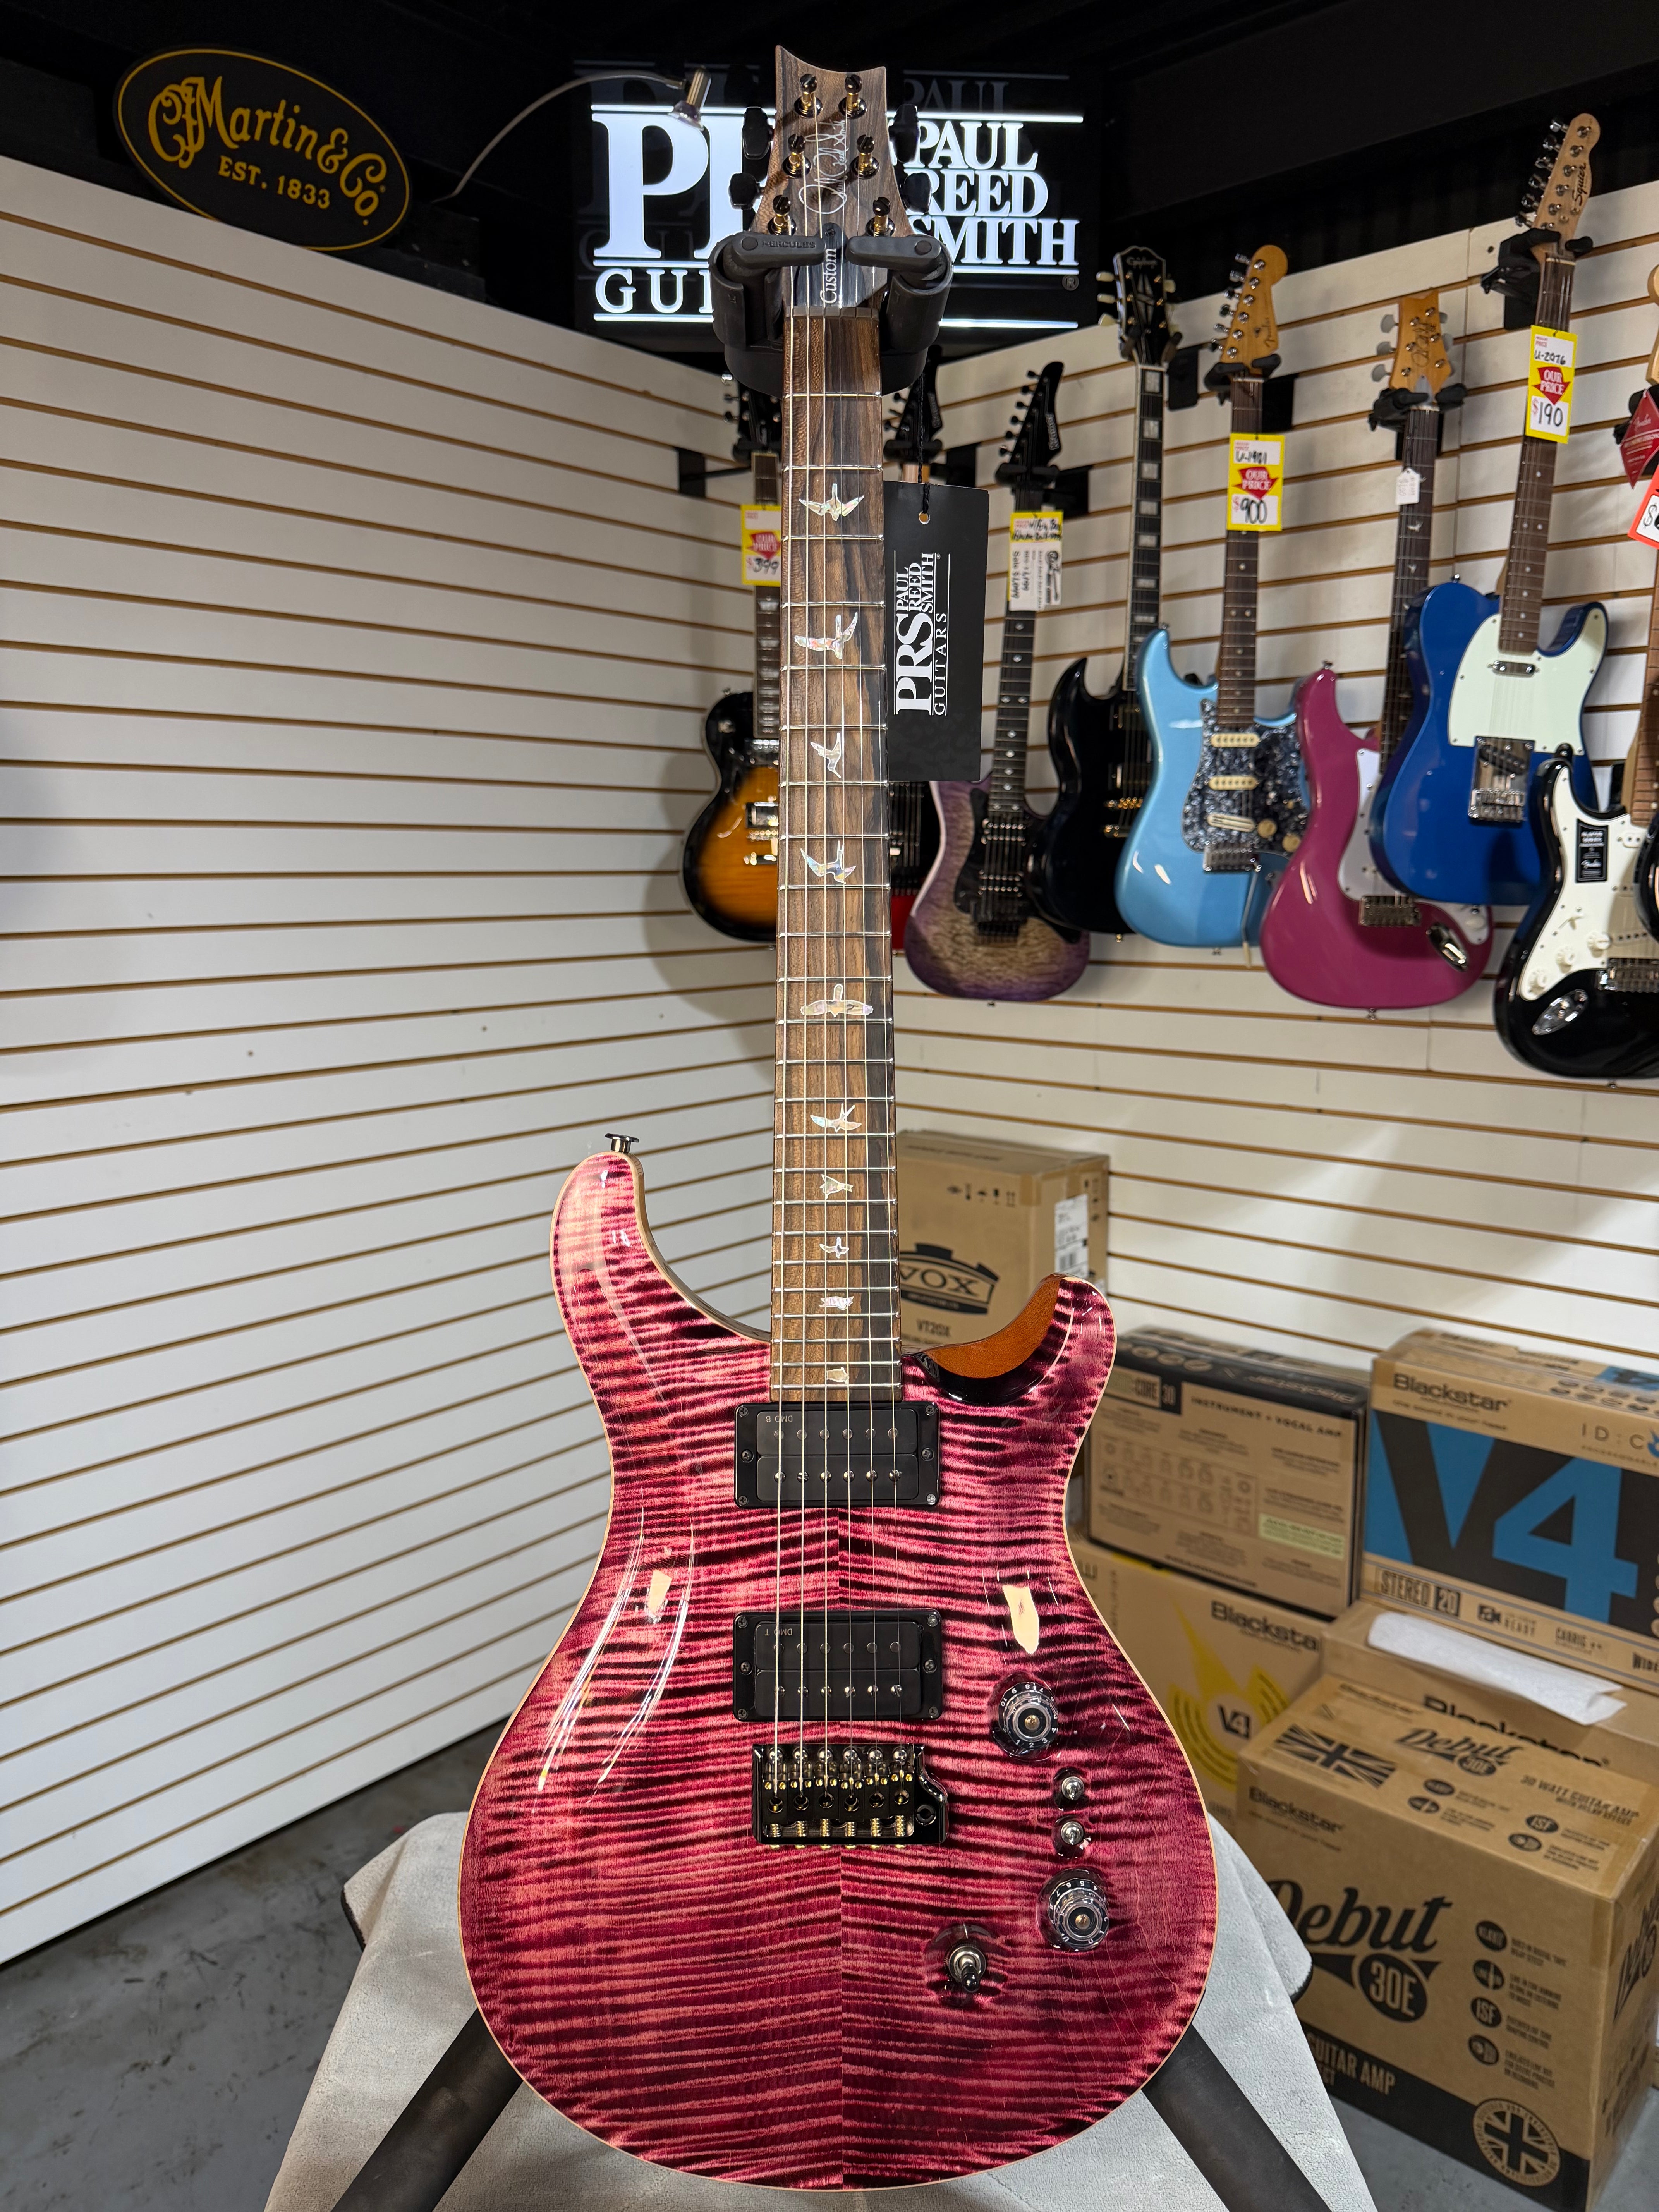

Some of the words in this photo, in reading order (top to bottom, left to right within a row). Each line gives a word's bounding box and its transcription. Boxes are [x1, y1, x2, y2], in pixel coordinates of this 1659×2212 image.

[218, 156, 267, 189] EST.
[277, 175, 330, 209] 1833
[1572, 162, 1587, 206] Squier
[762, 240, 816, 249] HERCULES
[820, 247, 837, 304] Custom
[1540, 380, 1565, 395] PRICE
[1543, 369, 1562, 383] OUR
[1531, 398, 1563, 427] $190
[1242, 480, 1272, 491] PRICE
[1245, 469, 1268, 481] OUR
[1232, 496, 1268, 524] $900
[896, 567, 909, 610] PAUL
[908, 562, 922, 611] REED
[921, 552, 934, 613] SMITH
[896, 612, 933, 715] PRS
[934, 613, 948, 716] GUITARS
[900, 1264, 980, 1297] VOX
[1393, 1373, 1509, 1412] Blackstar
[1275, 1415, 1313, 1432] VOCAL
[1381, 1570, 1431, 1607] STEREO
[1437, 1588, 1458, 1614] 20
[1211, 1600, 1319, 1652] Blacksta
[1395, 1728, 1524, 1760] Debut
[1538, 1780, 1569, 1797] WATT
[1266, 1879, 1453, 1953] Debut
[1369, 1961, 1416, 2018] 30E
[1307, 2033, 1358, 2078] GUITAR
[1360, 2060, 1396, 2095] AMP
